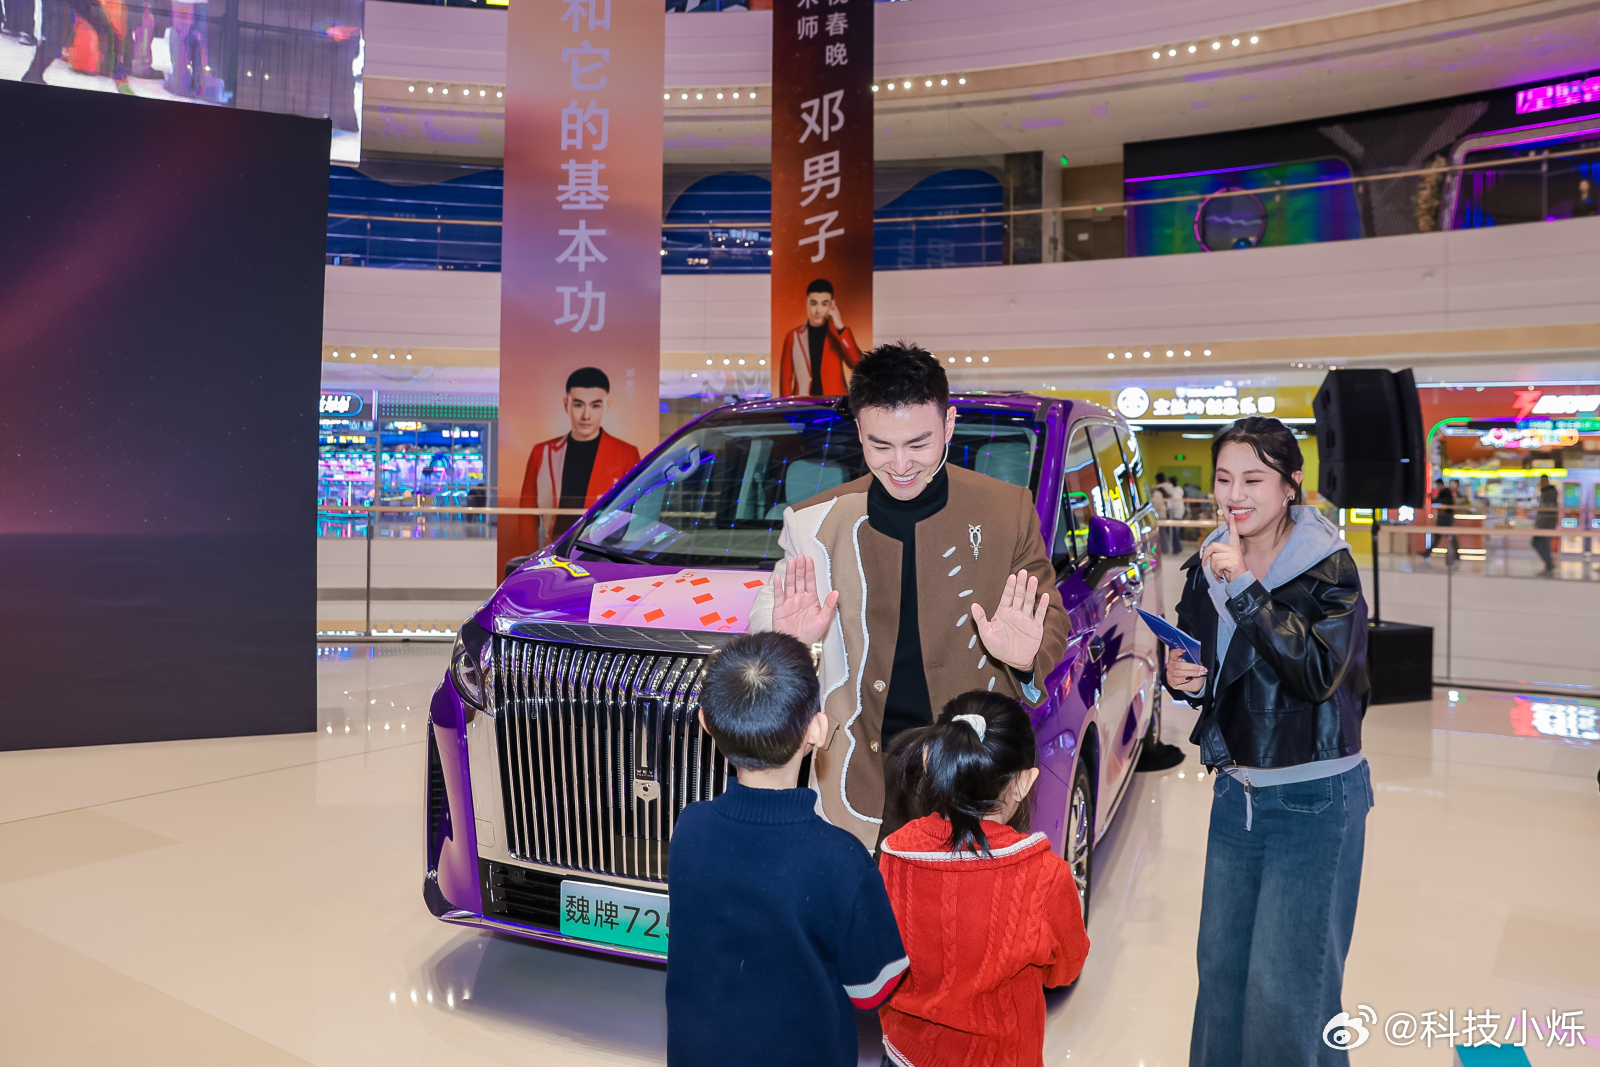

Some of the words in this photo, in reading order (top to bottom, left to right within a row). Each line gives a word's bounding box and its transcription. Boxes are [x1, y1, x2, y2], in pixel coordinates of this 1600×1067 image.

[825, 0, 848, 67] 春晚
[554, 0, 611, 333] 和它的基本功
[798, 89, 845, 264] 邓男子
[565, 895, 669, 938] 魏牌72
